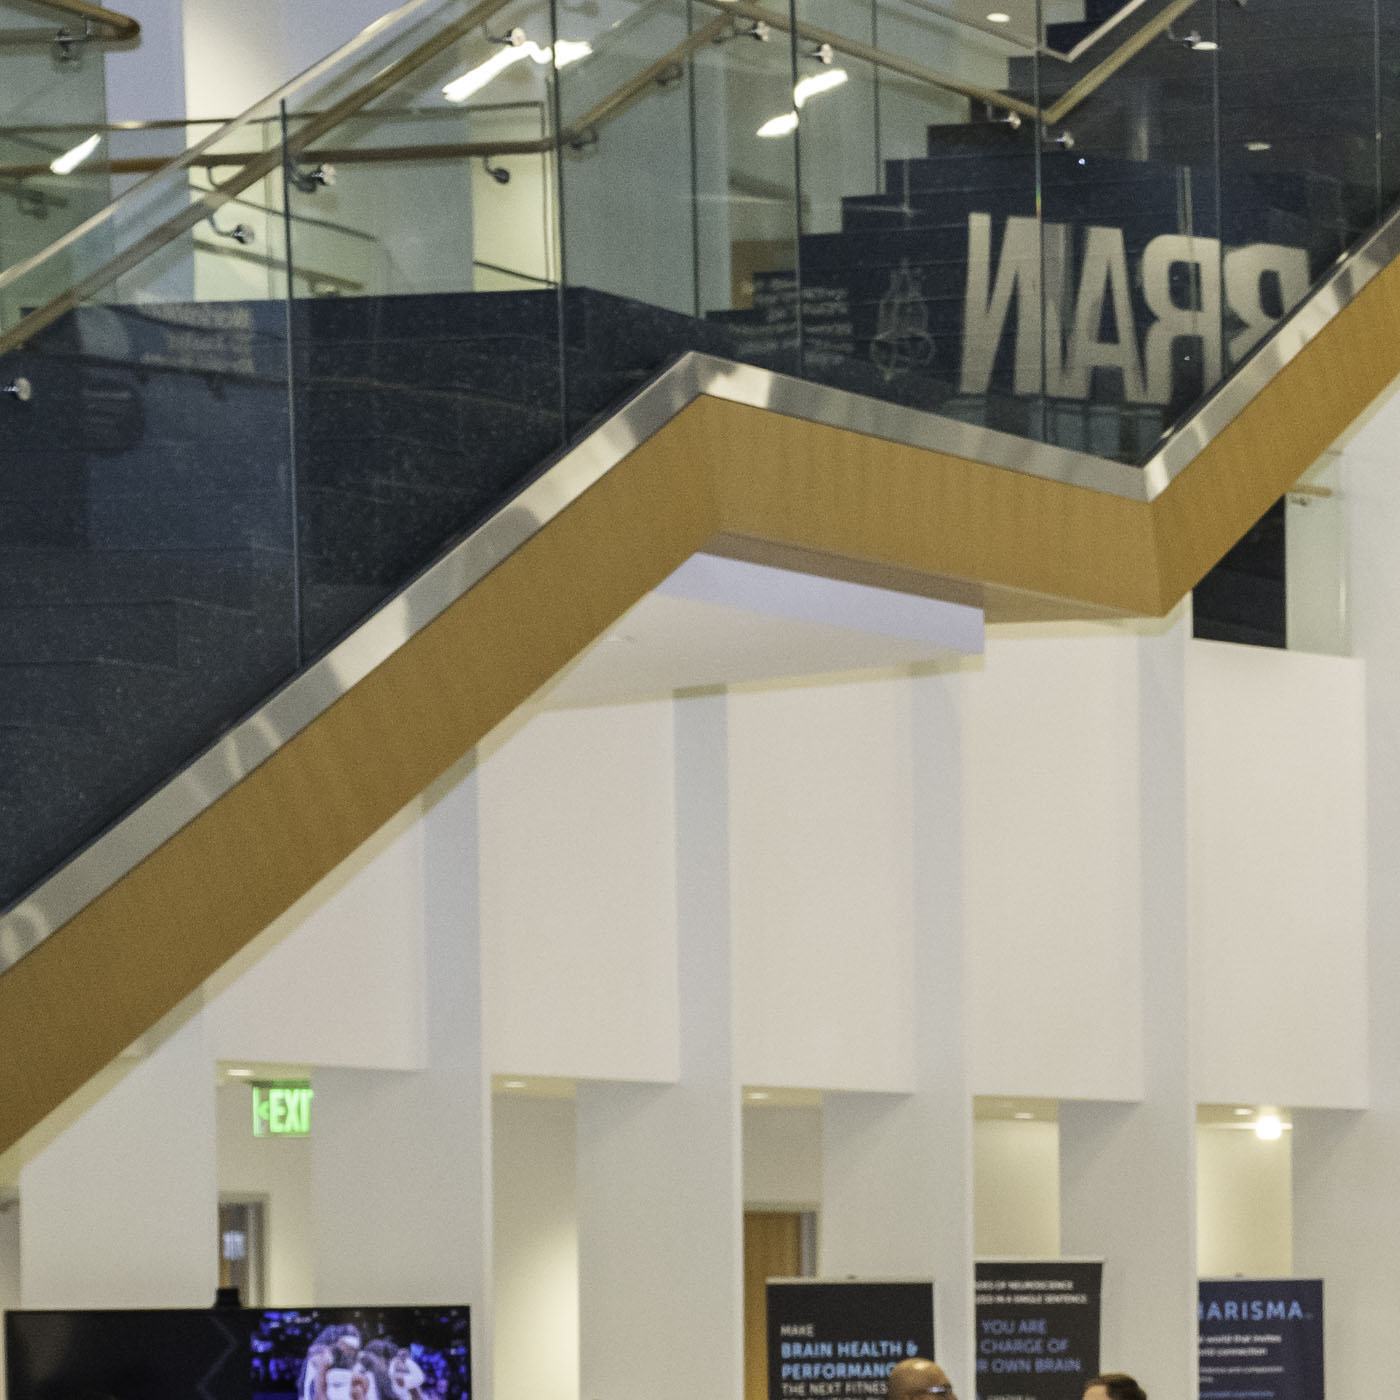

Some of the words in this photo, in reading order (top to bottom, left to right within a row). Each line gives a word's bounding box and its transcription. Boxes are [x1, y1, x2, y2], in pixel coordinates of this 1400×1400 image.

[781, 1324, 814, 1337] MAKE
[982, 1319, 1016, 1335] YOU
[1018, 1319, 1047, 1334] ARE
[781, 1341, 833, 1358] BRAIN
[837, 1340, 903, 1357] HEALTH
[980, 1338, 1043, 1354] CHARGE
[782, 1382, 805, 1396] THE
[808, 1382, 840, 1396] NEXT
[845, 1381, 889, 1395] FITNES
